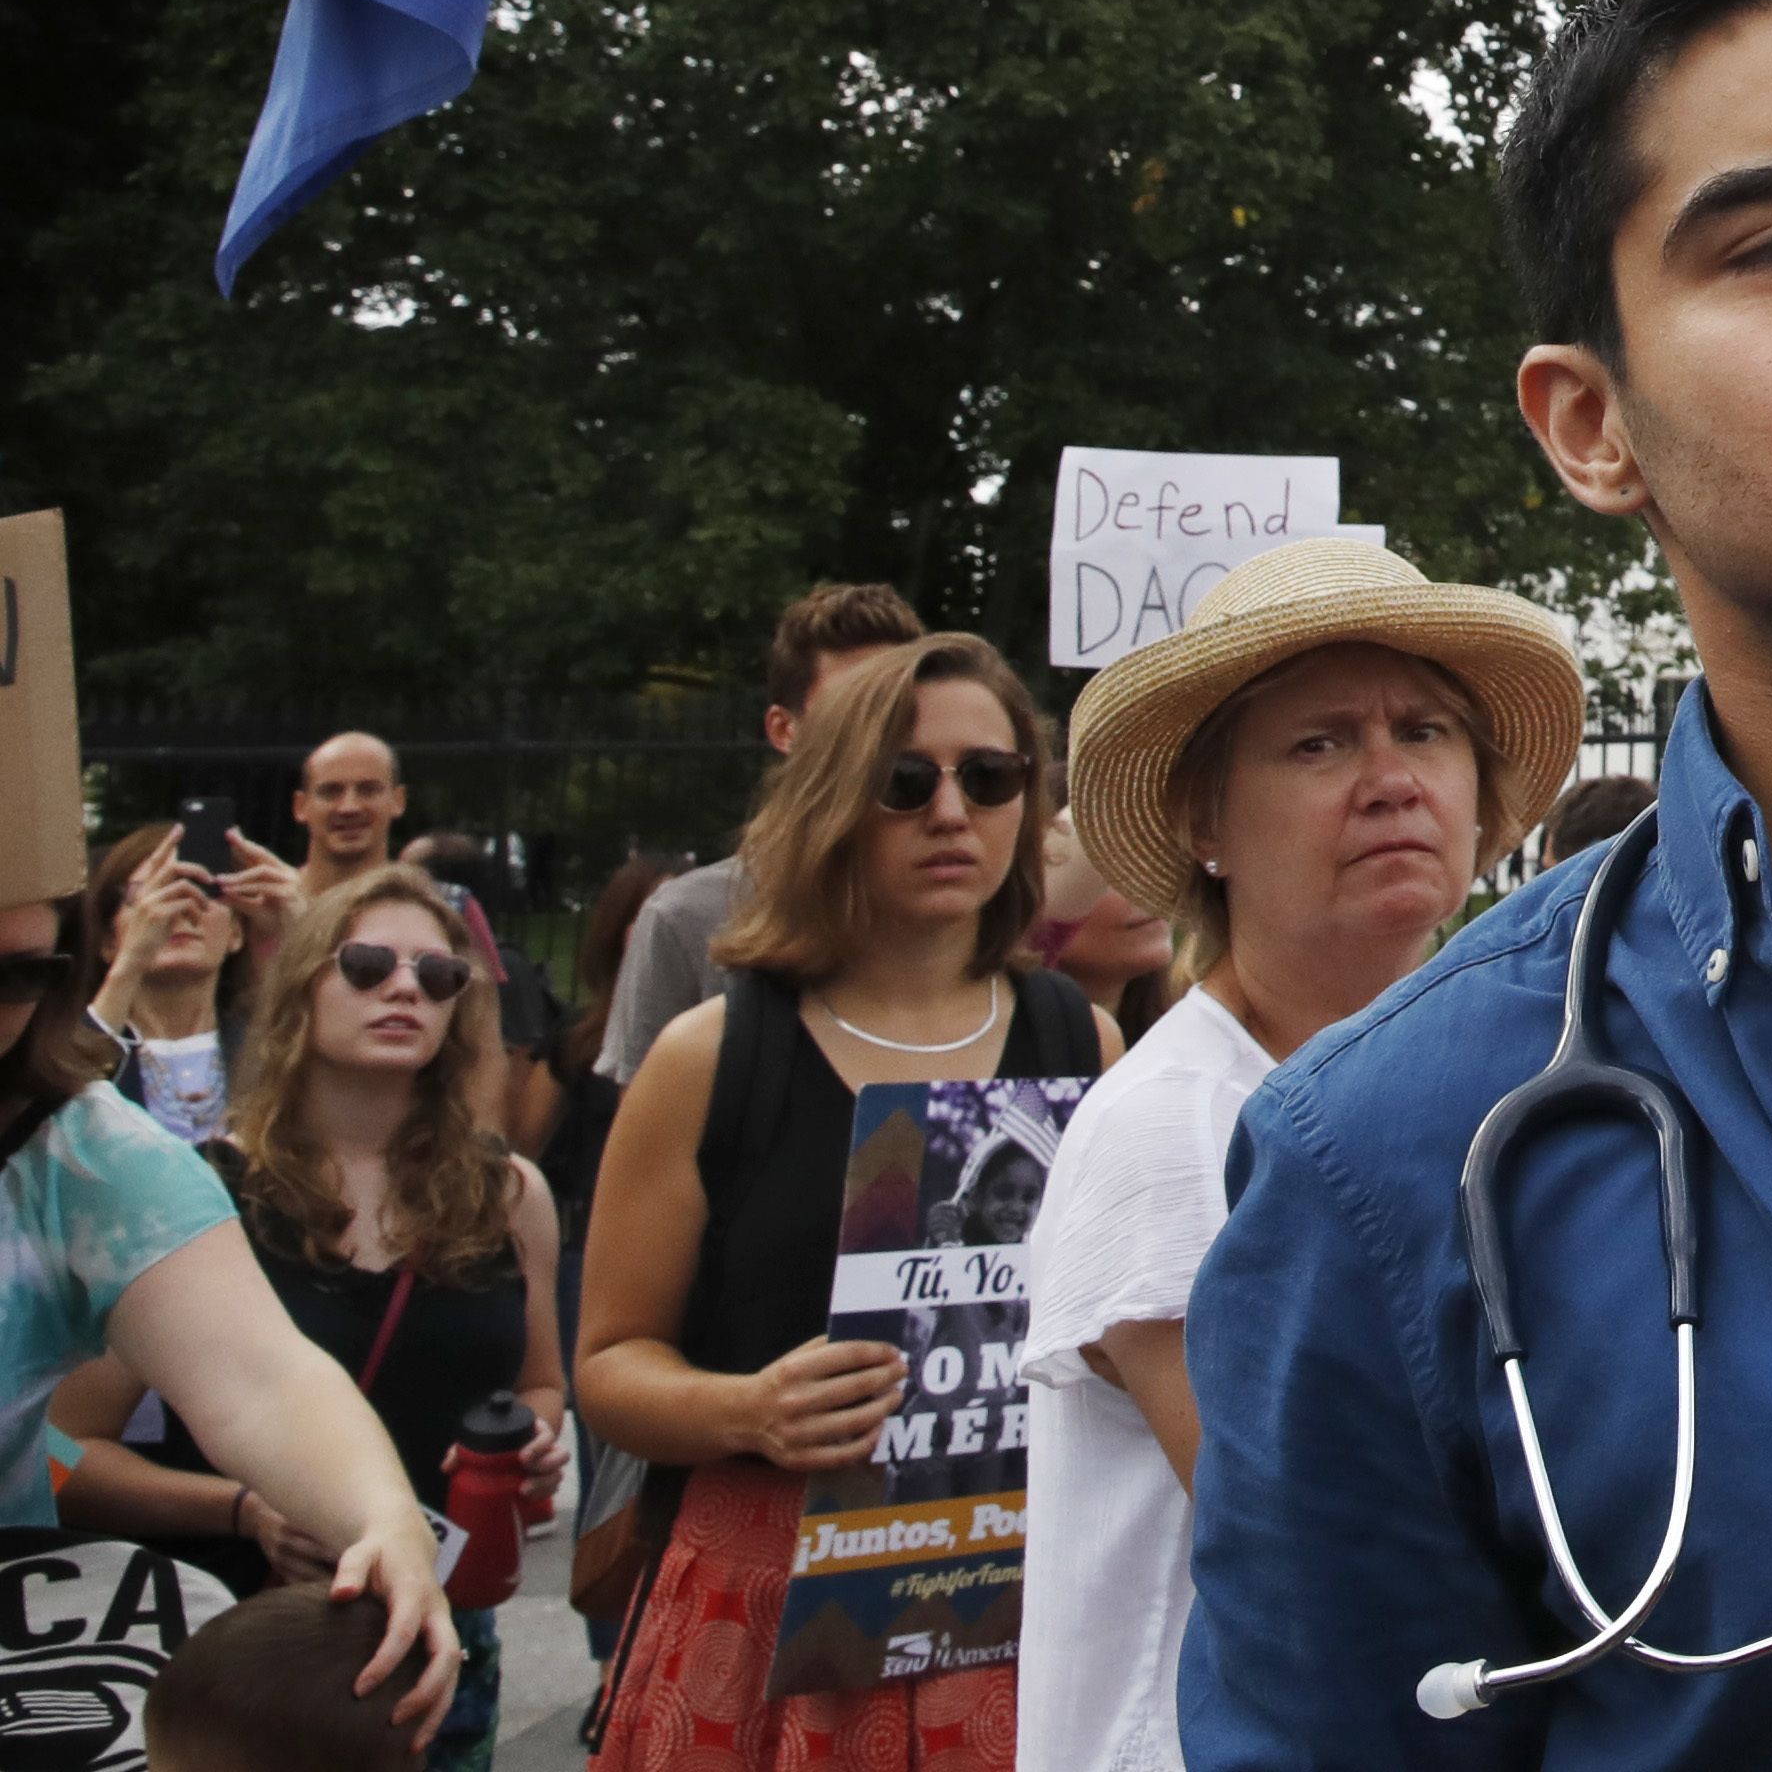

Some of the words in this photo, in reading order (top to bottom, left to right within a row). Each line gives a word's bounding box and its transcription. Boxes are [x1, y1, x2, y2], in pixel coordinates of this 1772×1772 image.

[1075, 467, 1290, 541] Defend
[1076, 562, 1231, 655] DAC
[897, 1256, 950, 1303] Tú,
[964, 1252, 1025, 1297] Yo,
[794, 1523, 957, 1573] ¡Juntos,
